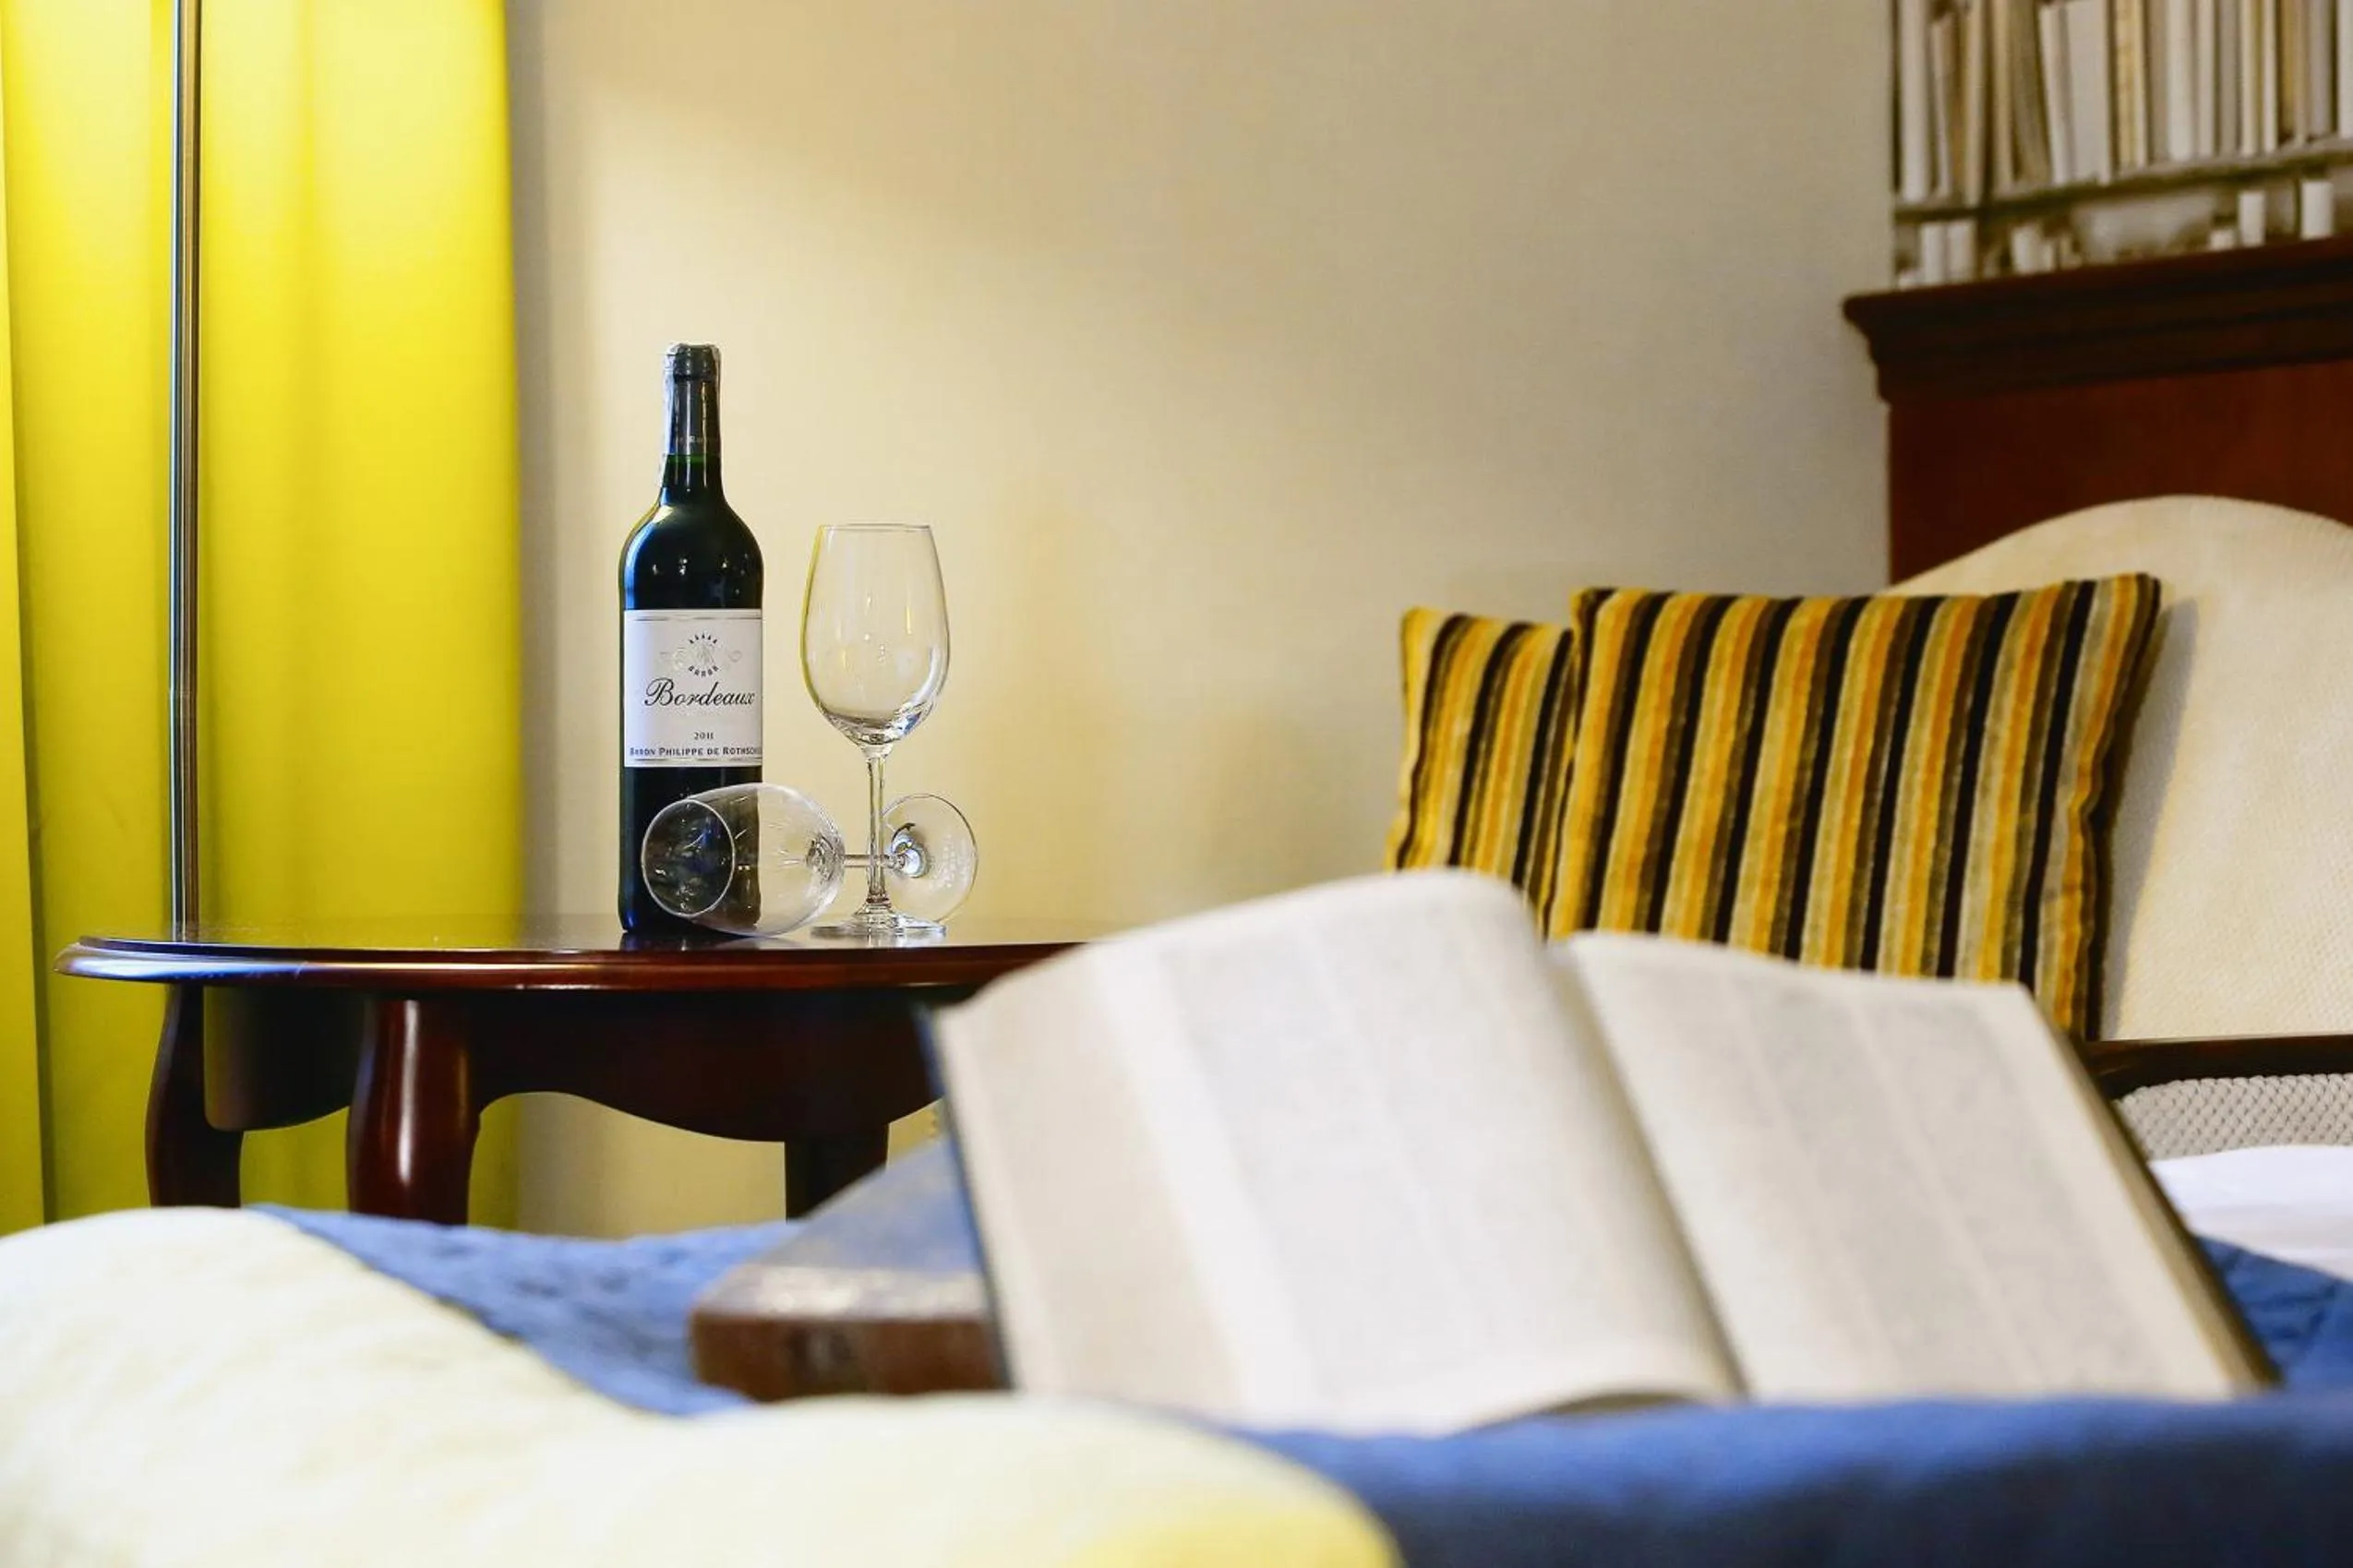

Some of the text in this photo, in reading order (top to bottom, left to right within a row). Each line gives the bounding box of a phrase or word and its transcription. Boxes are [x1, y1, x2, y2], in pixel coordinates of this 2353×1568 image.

[644, 677, 755, 706] Bordeaux
[693, 731, 714, 740] 2011
[659, 747, 702, 756] PHILIPPE
[707, 747, 719, 756] DE
